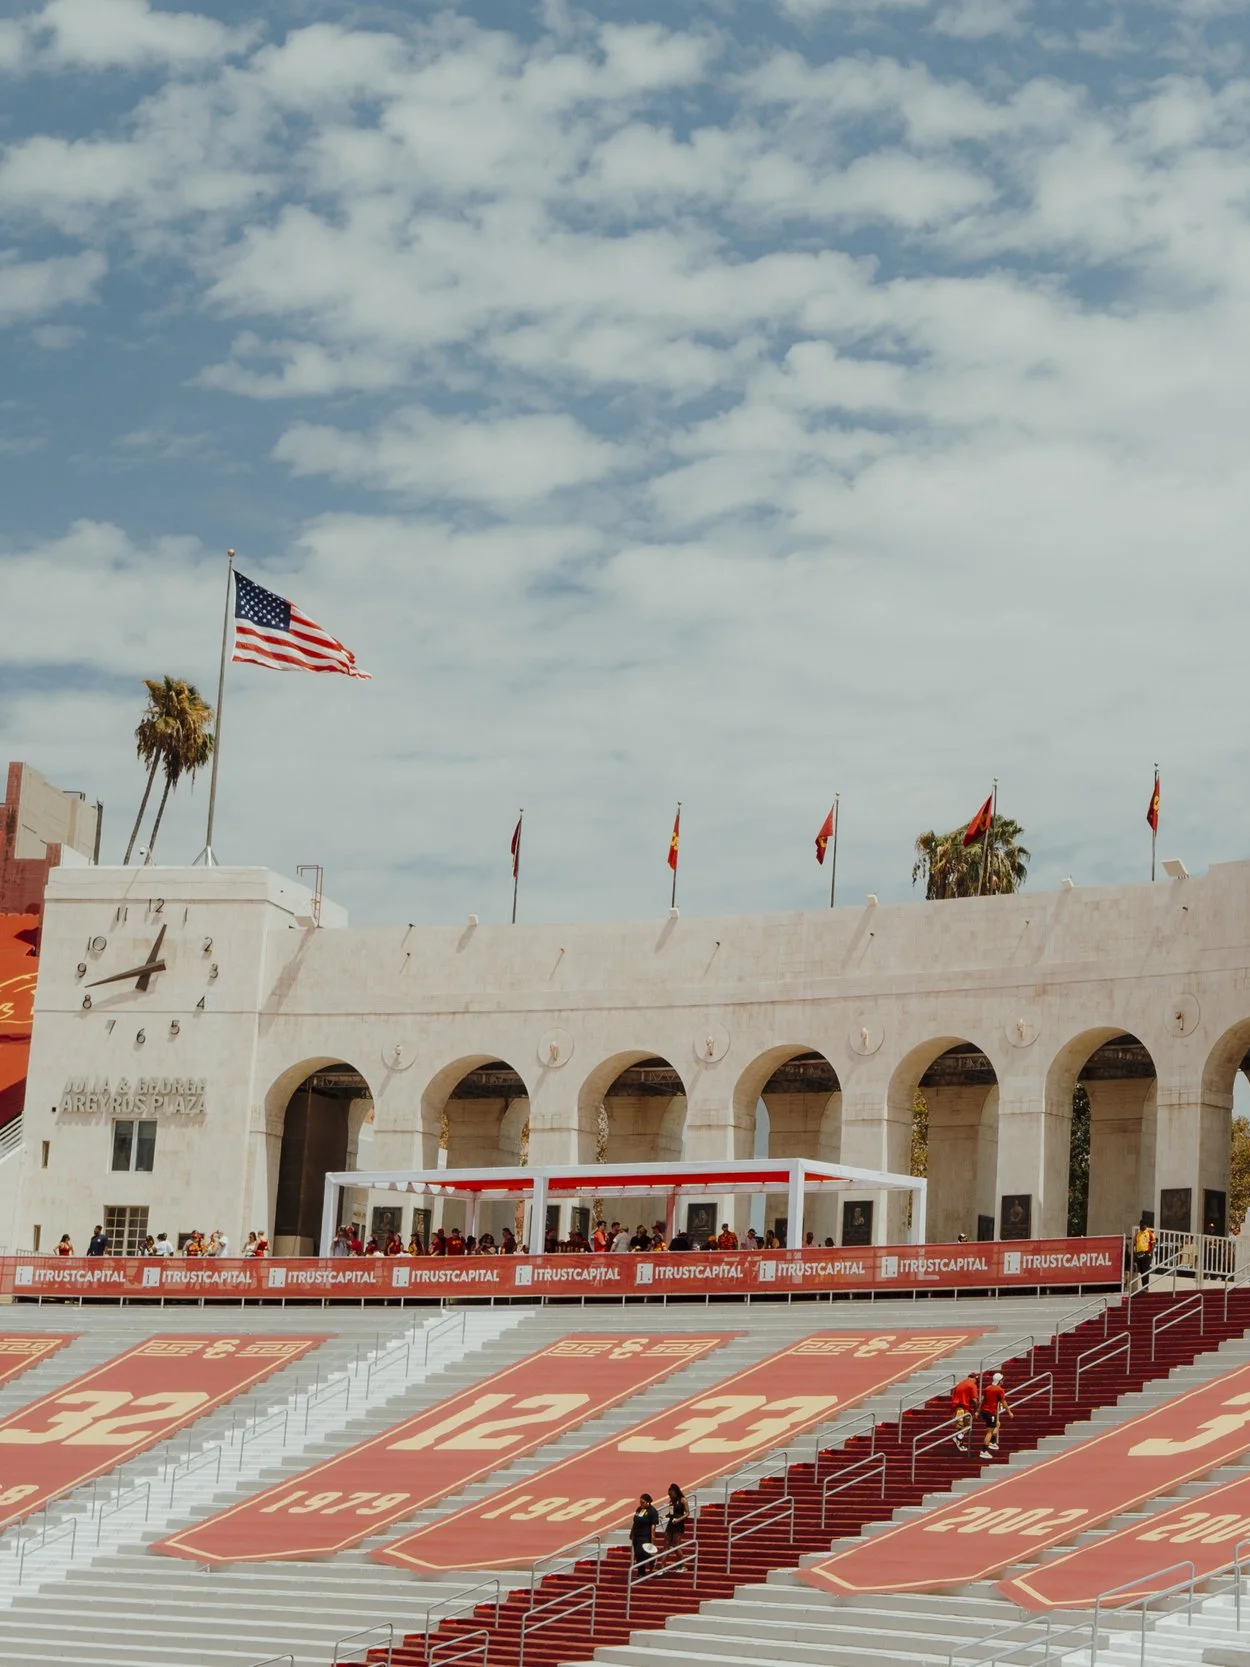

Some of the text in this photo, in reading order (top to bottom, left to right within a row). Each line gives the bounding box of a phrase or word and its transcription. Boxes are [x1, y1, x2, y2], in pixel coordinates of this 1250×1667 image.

[149, 898, 165, 913] 12
[116, 907, 128, 922] 11
[87, 936, 107, 952] 10
[203, 936, 213, 952] 2
[77, 962, 87, 978] 9
[210, 963, 219, 979] 3
[82, 994, 92, 1010] 8
[196, 995, 205, 1010] 4
[106, 1019, 117, 1035] 7
[170, 1019, 180, 1035] 5
[136, 1028, 146, 1044] 6
[119, 1076, 131, 1093] &
[137, 1076, 207, 1094] GEORGE
[62, 1095, 207, 1114] ARGYROS PLAZA
[900, 1257, 988, 1273] ITRUSTCAPITAL
[1022, 1253, 1112, 1268] ITRUSTCAPITAL
[34, 1268, 126, 1283] ITRUSTCAPITAL
[161, 1270, 252, 1284] ITRUSTCAPITAL
[411, 1269, 499, 1283] ITRUSTCAPITAL
[533, 1267, 619, 1281] ITRUSTCAPITAL
[655, 1265, 743, 1279] ITRUSTCAPITAL
[777, 1261, 865, 1277] ITRUSTCAPITAL
[287, 1270, 377, 1285] ITRUSTCAPITAL
[0, 1390, 210, 1445] 32
[386, 1394, 590, 1450] 12
[618, 1395, 838, 1453] 33
[260, 1491, 410, 1514] 1979
[480, 1496, 635, 1522] 1981
[923, 1507, 1088, 1535] 2002
